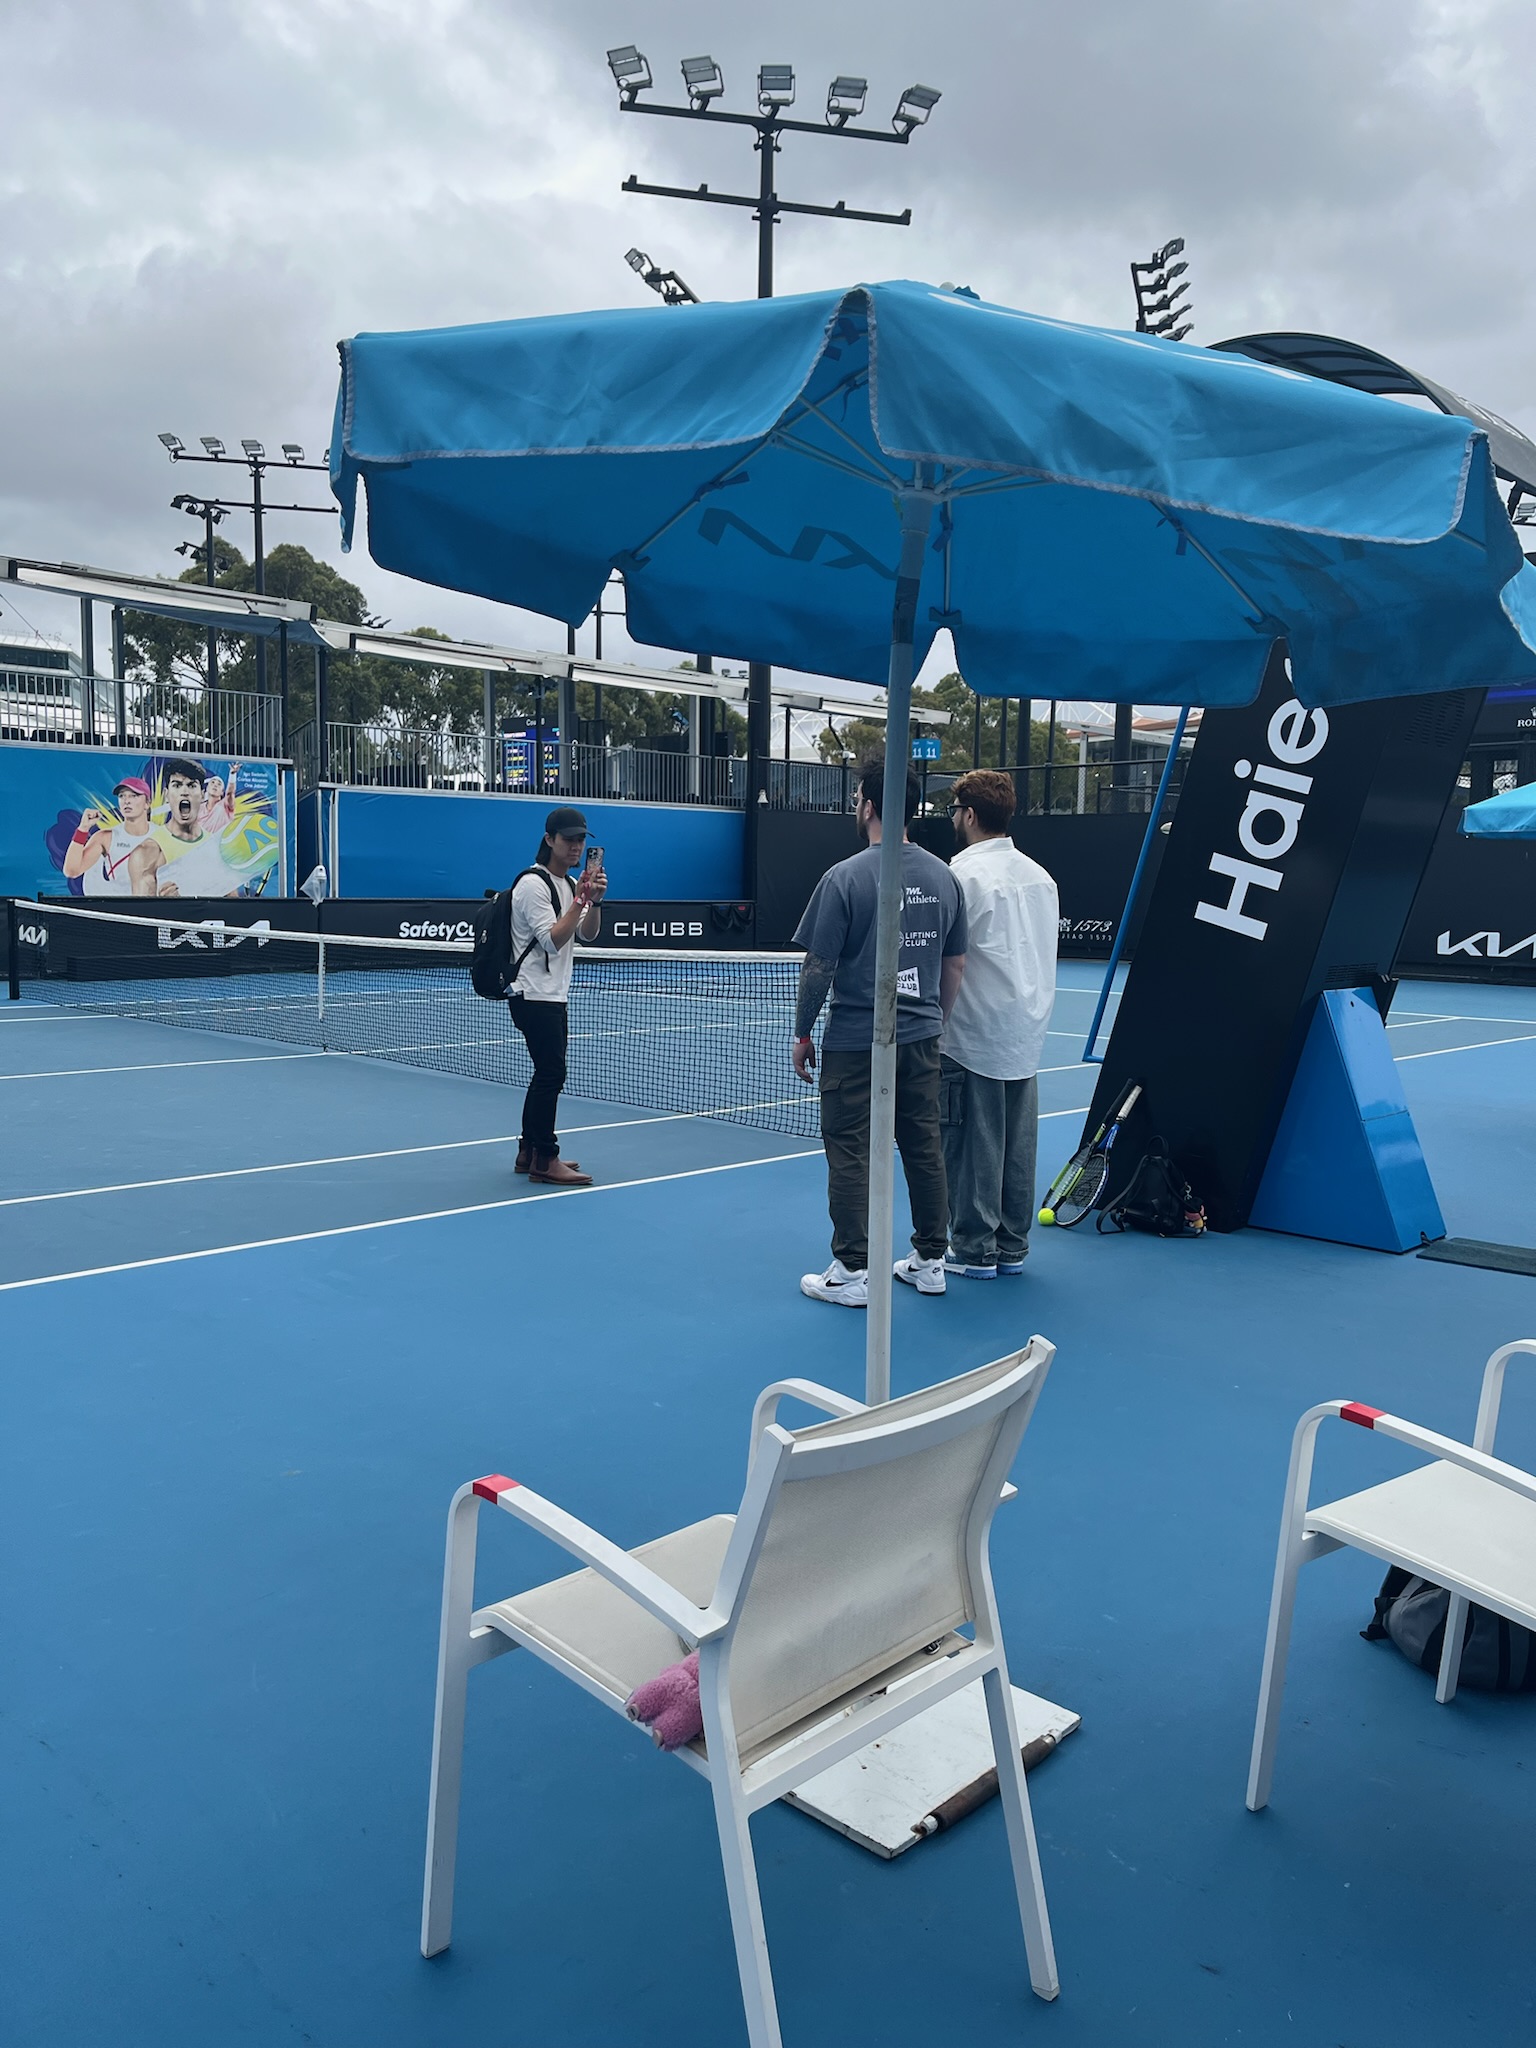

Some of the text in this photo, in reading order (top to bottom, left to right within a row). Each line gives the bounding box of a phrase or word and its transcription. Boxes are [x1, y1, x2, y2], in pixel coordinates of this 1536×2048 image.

[912, 748, 936, 758] 11 11
[1194, 658, 1329, 941] Haie
[906, 887, 922, 895] TWL
[906, 895, 940, 905] Athlete.
[614, 922, 703, 937] CHUBB
[905, 931, 937, 940] LIFTING
[905, 939, 929, 947] CLUB.
